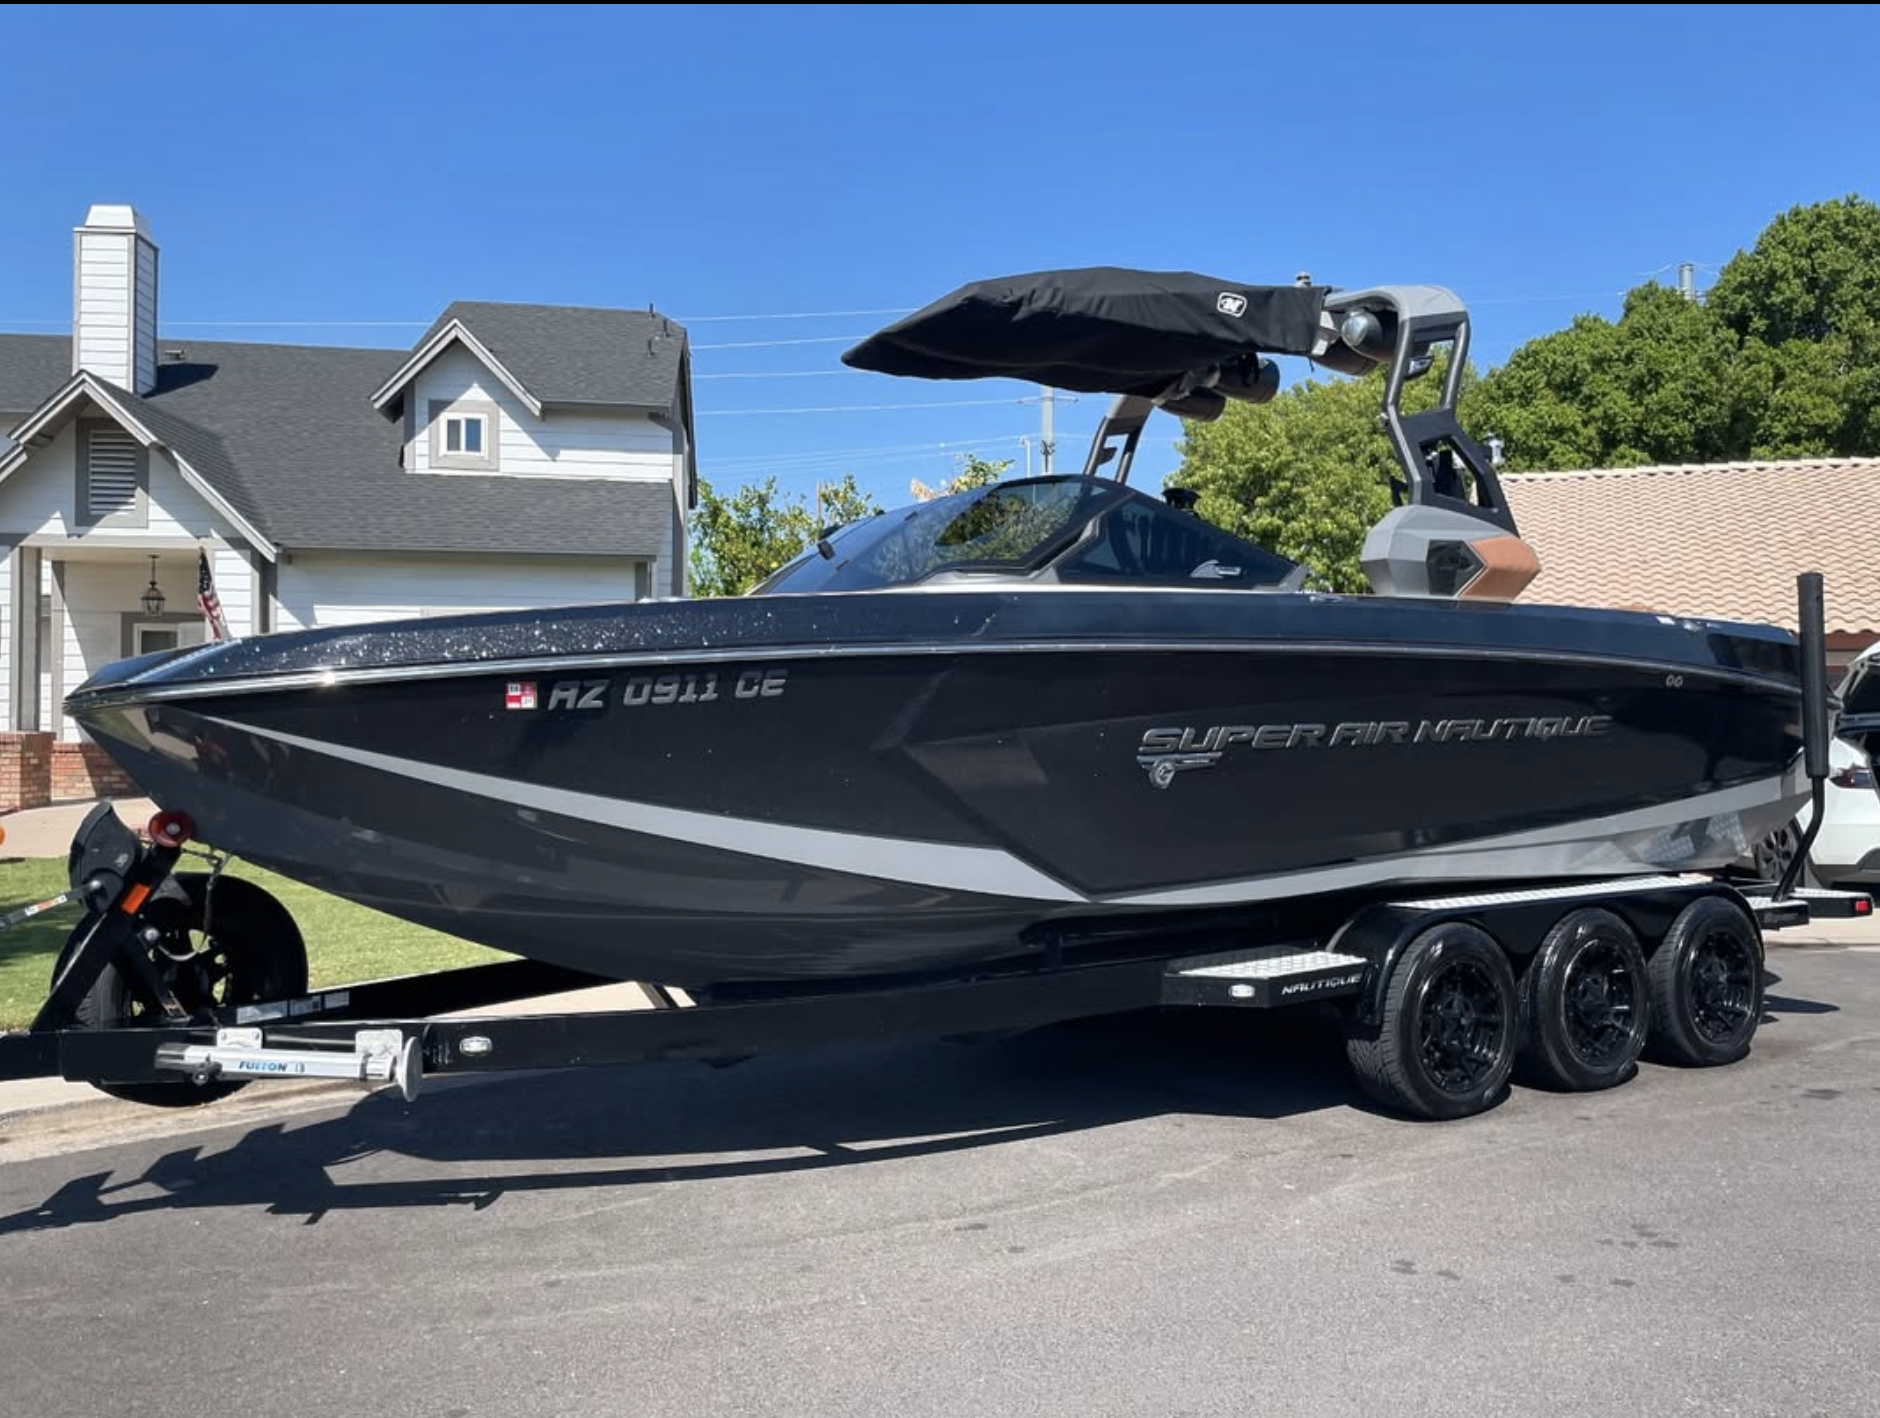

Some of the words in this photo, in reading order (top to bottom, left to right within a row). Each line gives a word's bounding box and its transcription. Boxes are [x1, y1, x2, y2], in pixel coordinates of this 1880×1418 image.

[548, 680, 609, 710] AZ
[623, 674, 718, 706] 0911
[1138, 723, 1326, 751] SUPER
[1329, 722, 1409, 746] AIR
[1413, 715, 1612, 743] NAUTIQUE
[1281, 974, 1360, 995] NAUTIQUE
